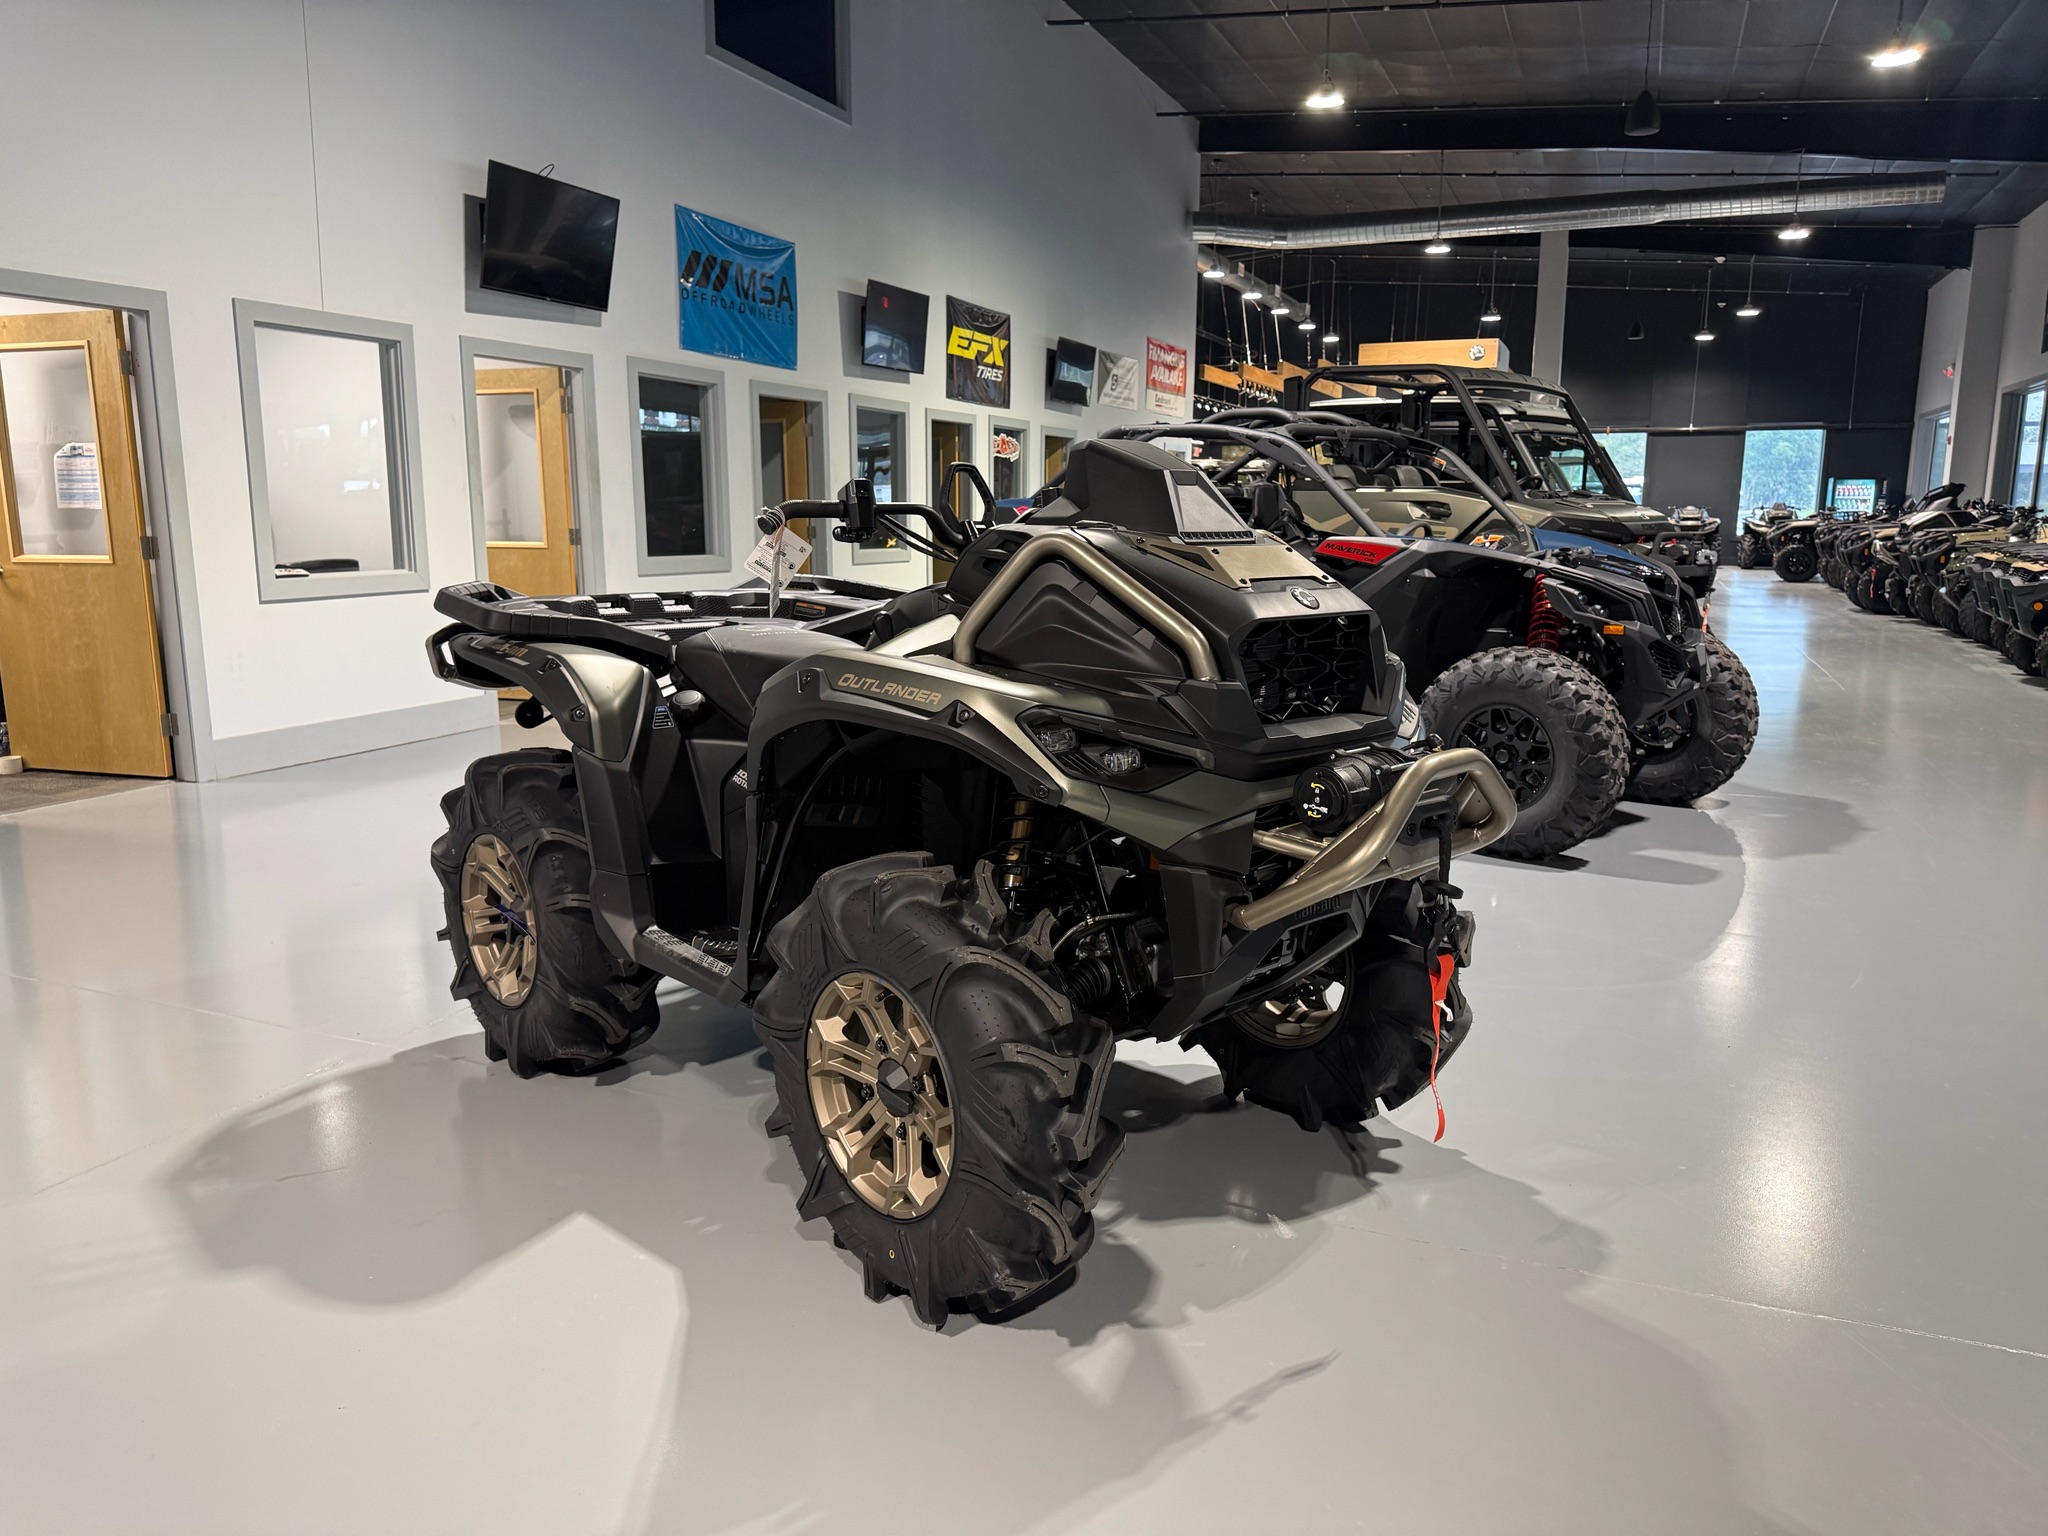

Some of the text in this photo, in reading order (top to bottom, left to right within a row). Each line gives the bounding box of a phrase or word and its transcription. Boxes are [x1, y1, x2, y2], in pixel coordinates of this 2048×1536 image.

[735, 263, 794, 311] MSA
[750, 304, 795, 325] WHEELS
[947, 325, 1009, 367] EFX
[976, 365, 1004, 382] TIRES
[1324, 542, 1378, 558] MAVERICK
[837, 673, 943, 705] OUTLANDER
